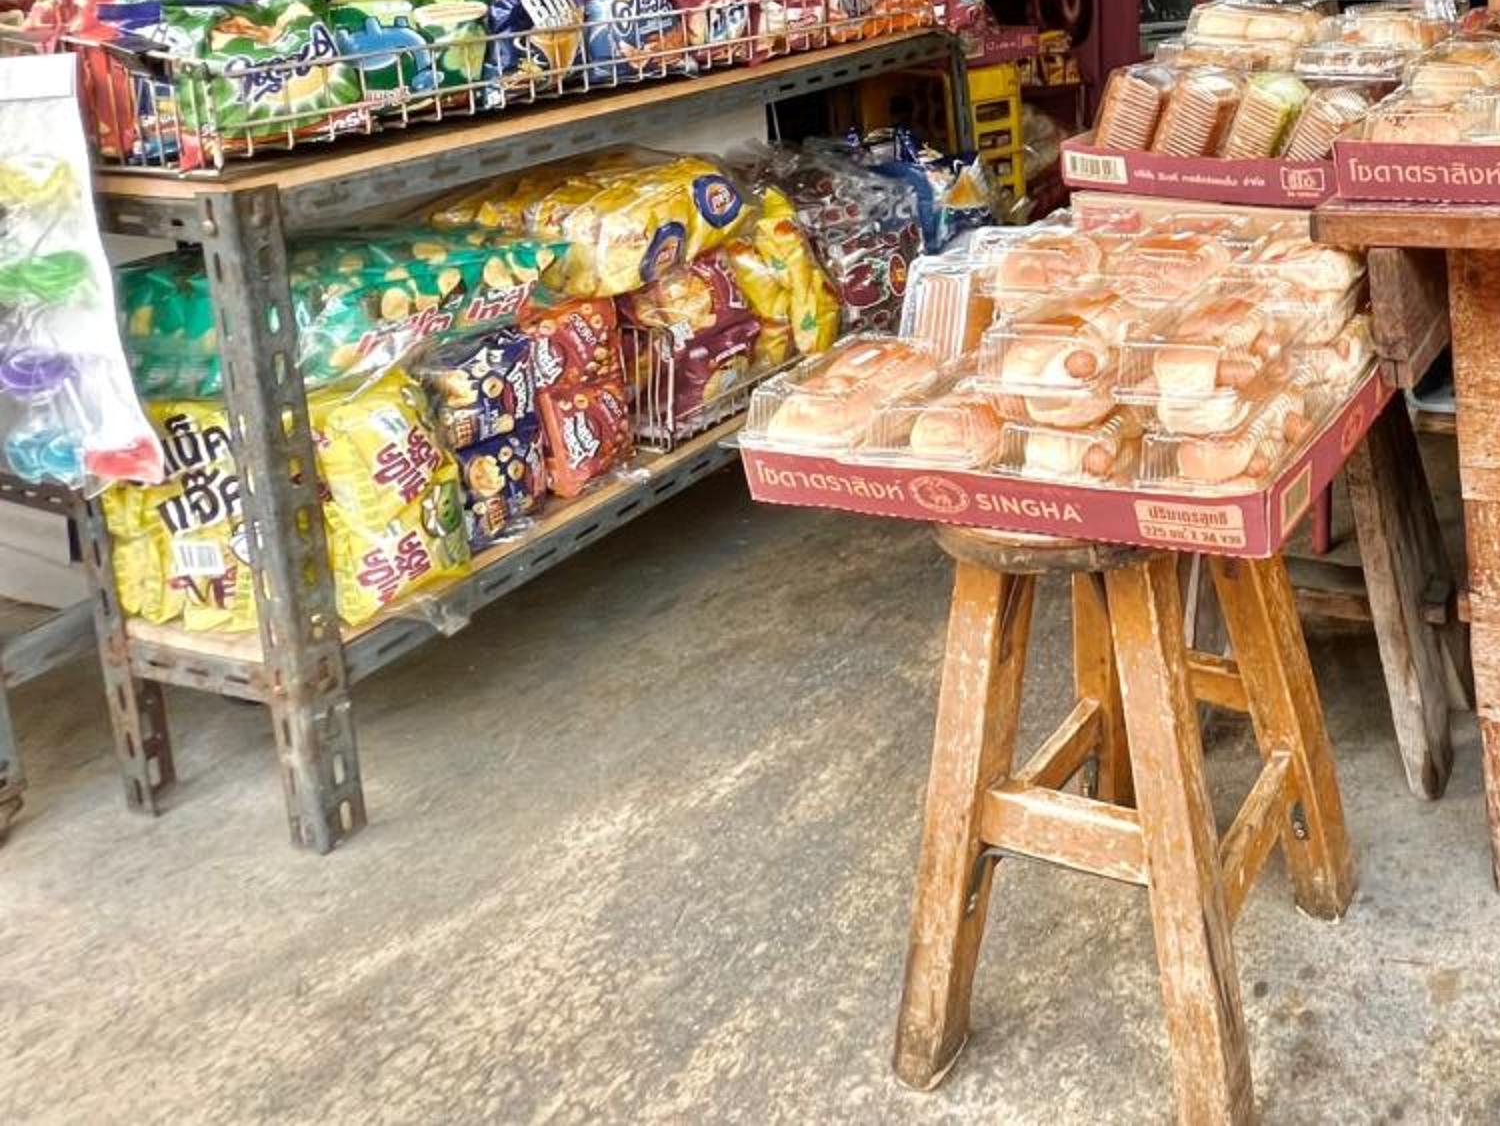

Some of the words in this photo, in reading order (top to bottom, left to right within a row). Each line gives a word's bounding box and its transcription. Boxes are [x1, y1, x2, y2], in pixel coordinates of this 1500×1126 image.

[755, 459, 906, 502] โซดาตราสิงห์
[975, 493, 1083, 524] SINGHA
